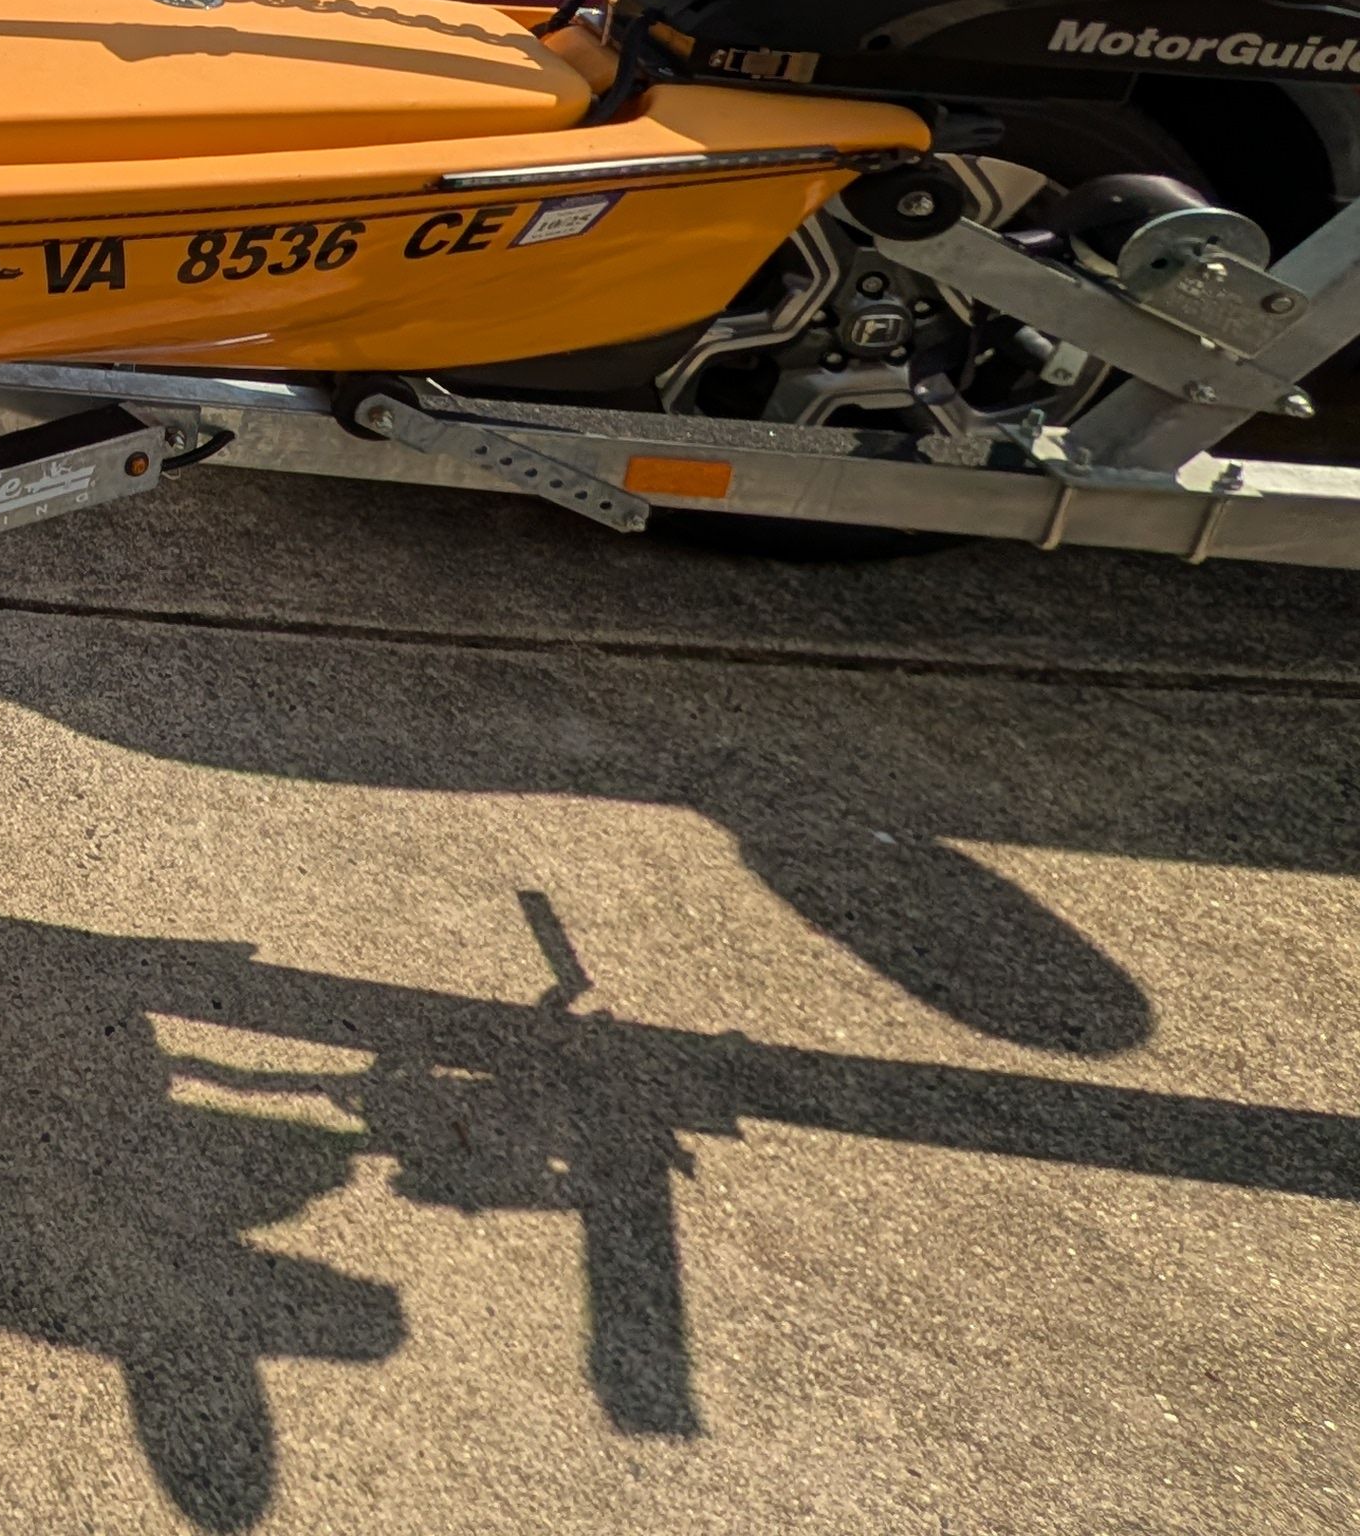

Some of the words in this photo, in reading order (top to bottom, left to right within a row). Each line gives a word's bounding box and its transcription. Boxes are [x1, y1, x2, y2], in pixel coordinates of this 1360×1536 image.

[42, 235, 126, 295] VA
[177, 220, 367, 285] 8536
[403, 206, 518, 261] CE
